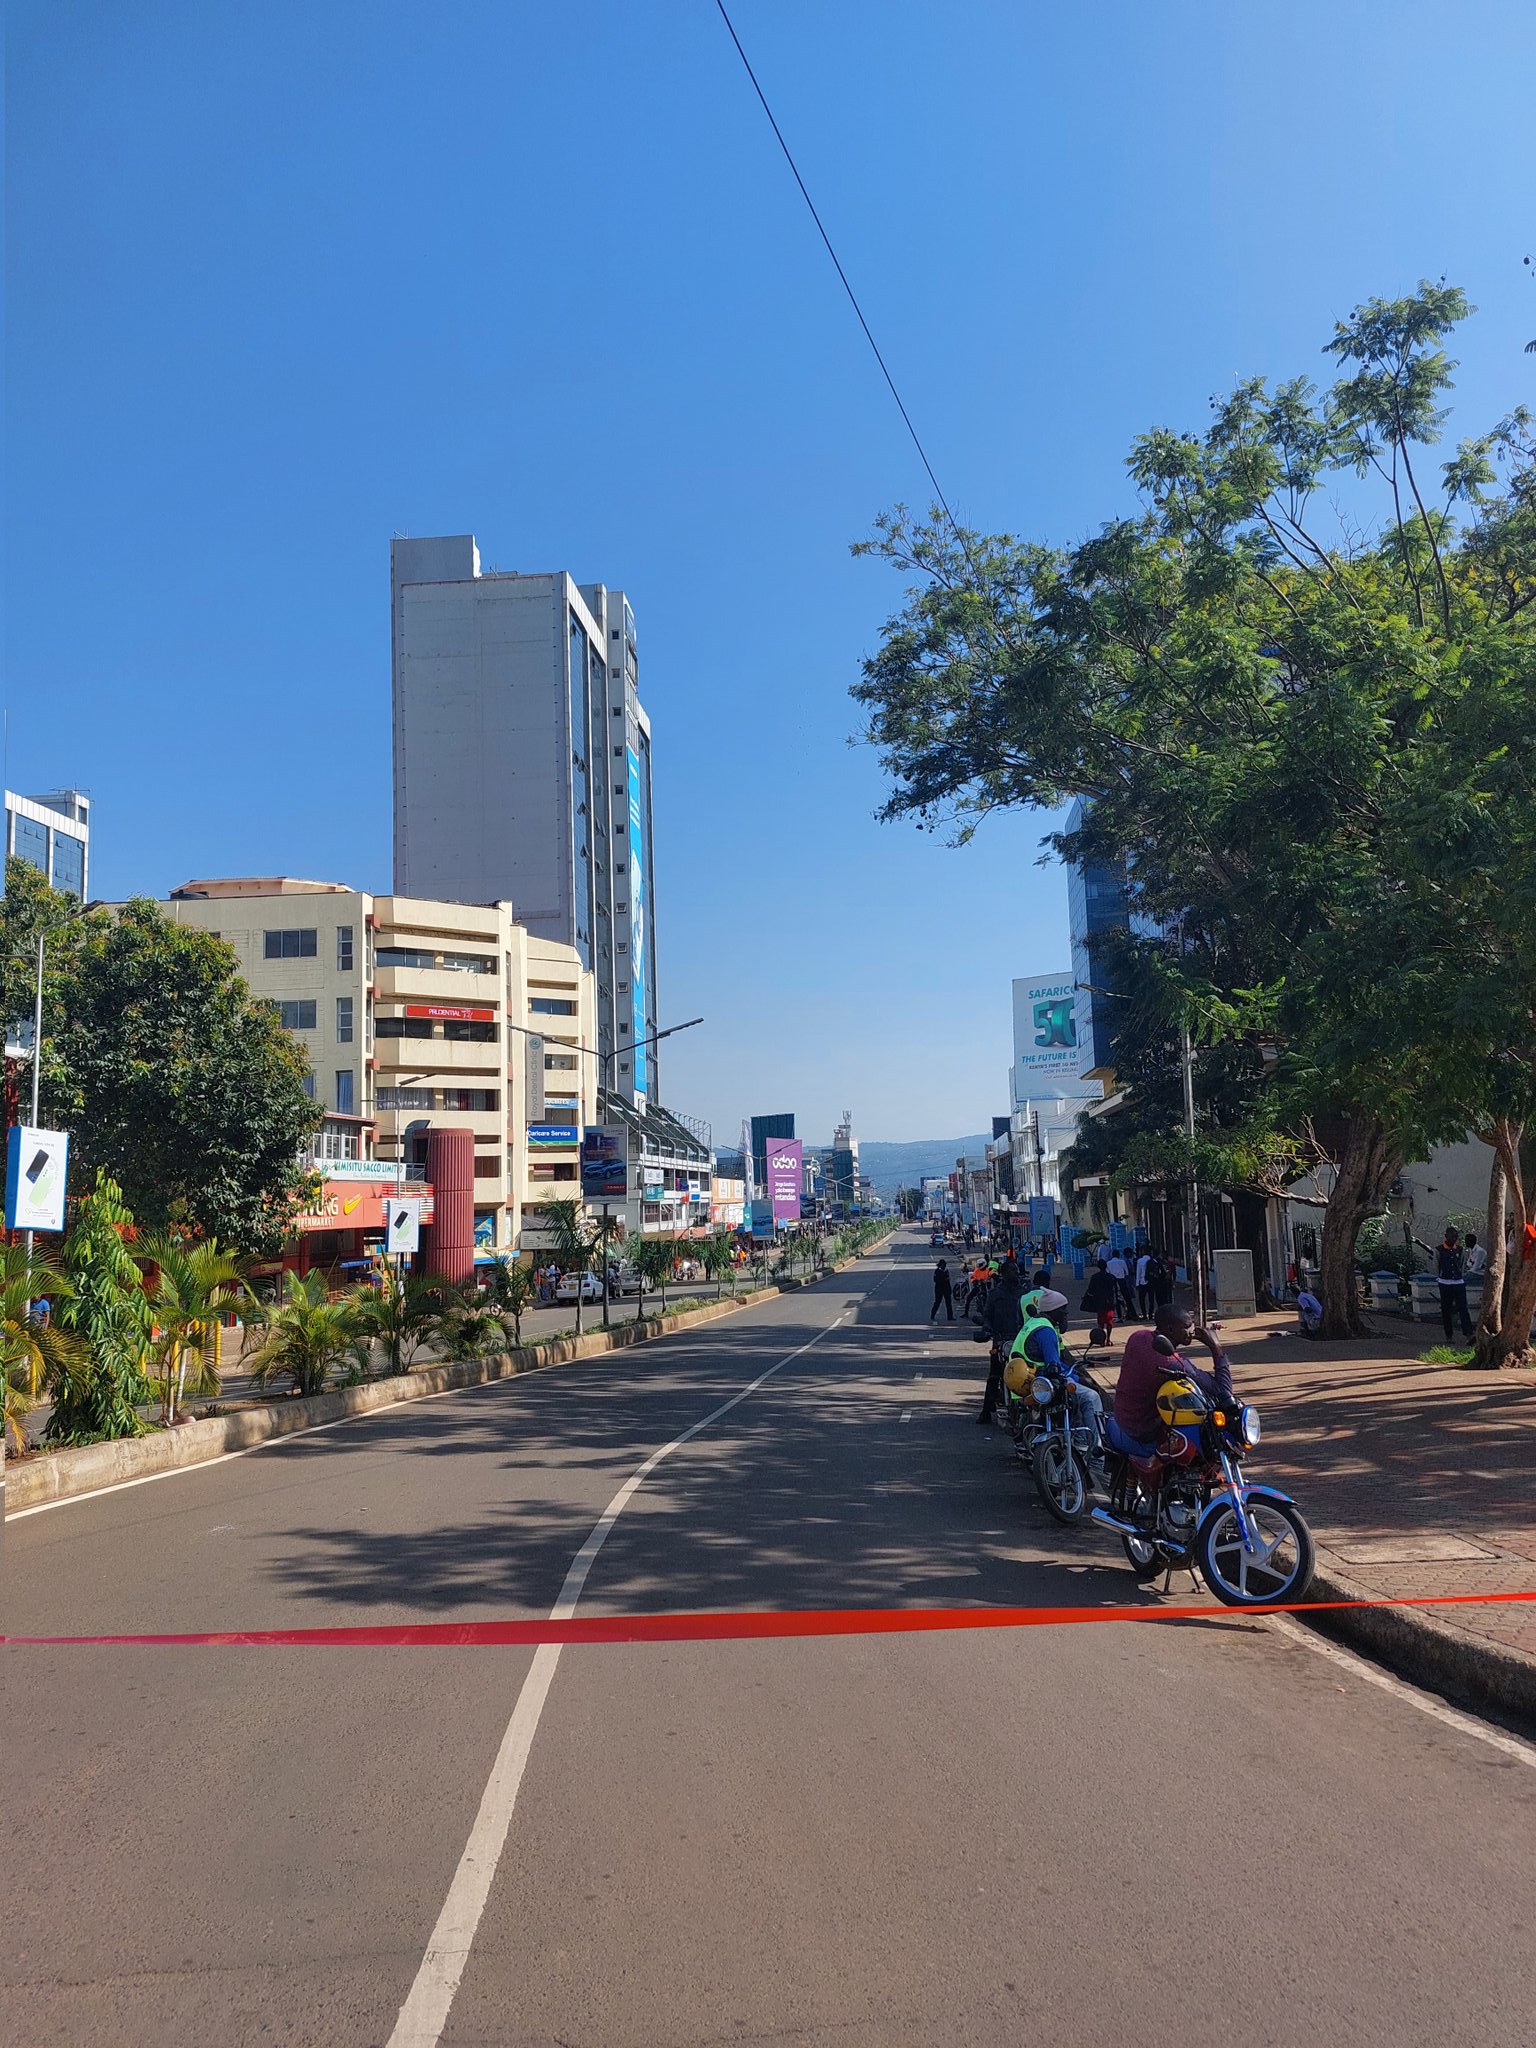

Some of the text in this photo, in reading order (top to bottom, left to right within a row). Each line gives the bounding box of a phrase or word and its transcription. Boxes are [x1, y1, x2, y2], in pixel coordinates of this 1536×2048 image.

[428, 1008, 461, 1017] PRUDENTIAL
[1021, 1051, 1077, 1063] THE FUTURE IS
[530, 1050, 538, 1117] Royal Dental Clinic
[363, 1162, 380, 1173] SACCO
[773, 1154, 797, 1169] odoo
